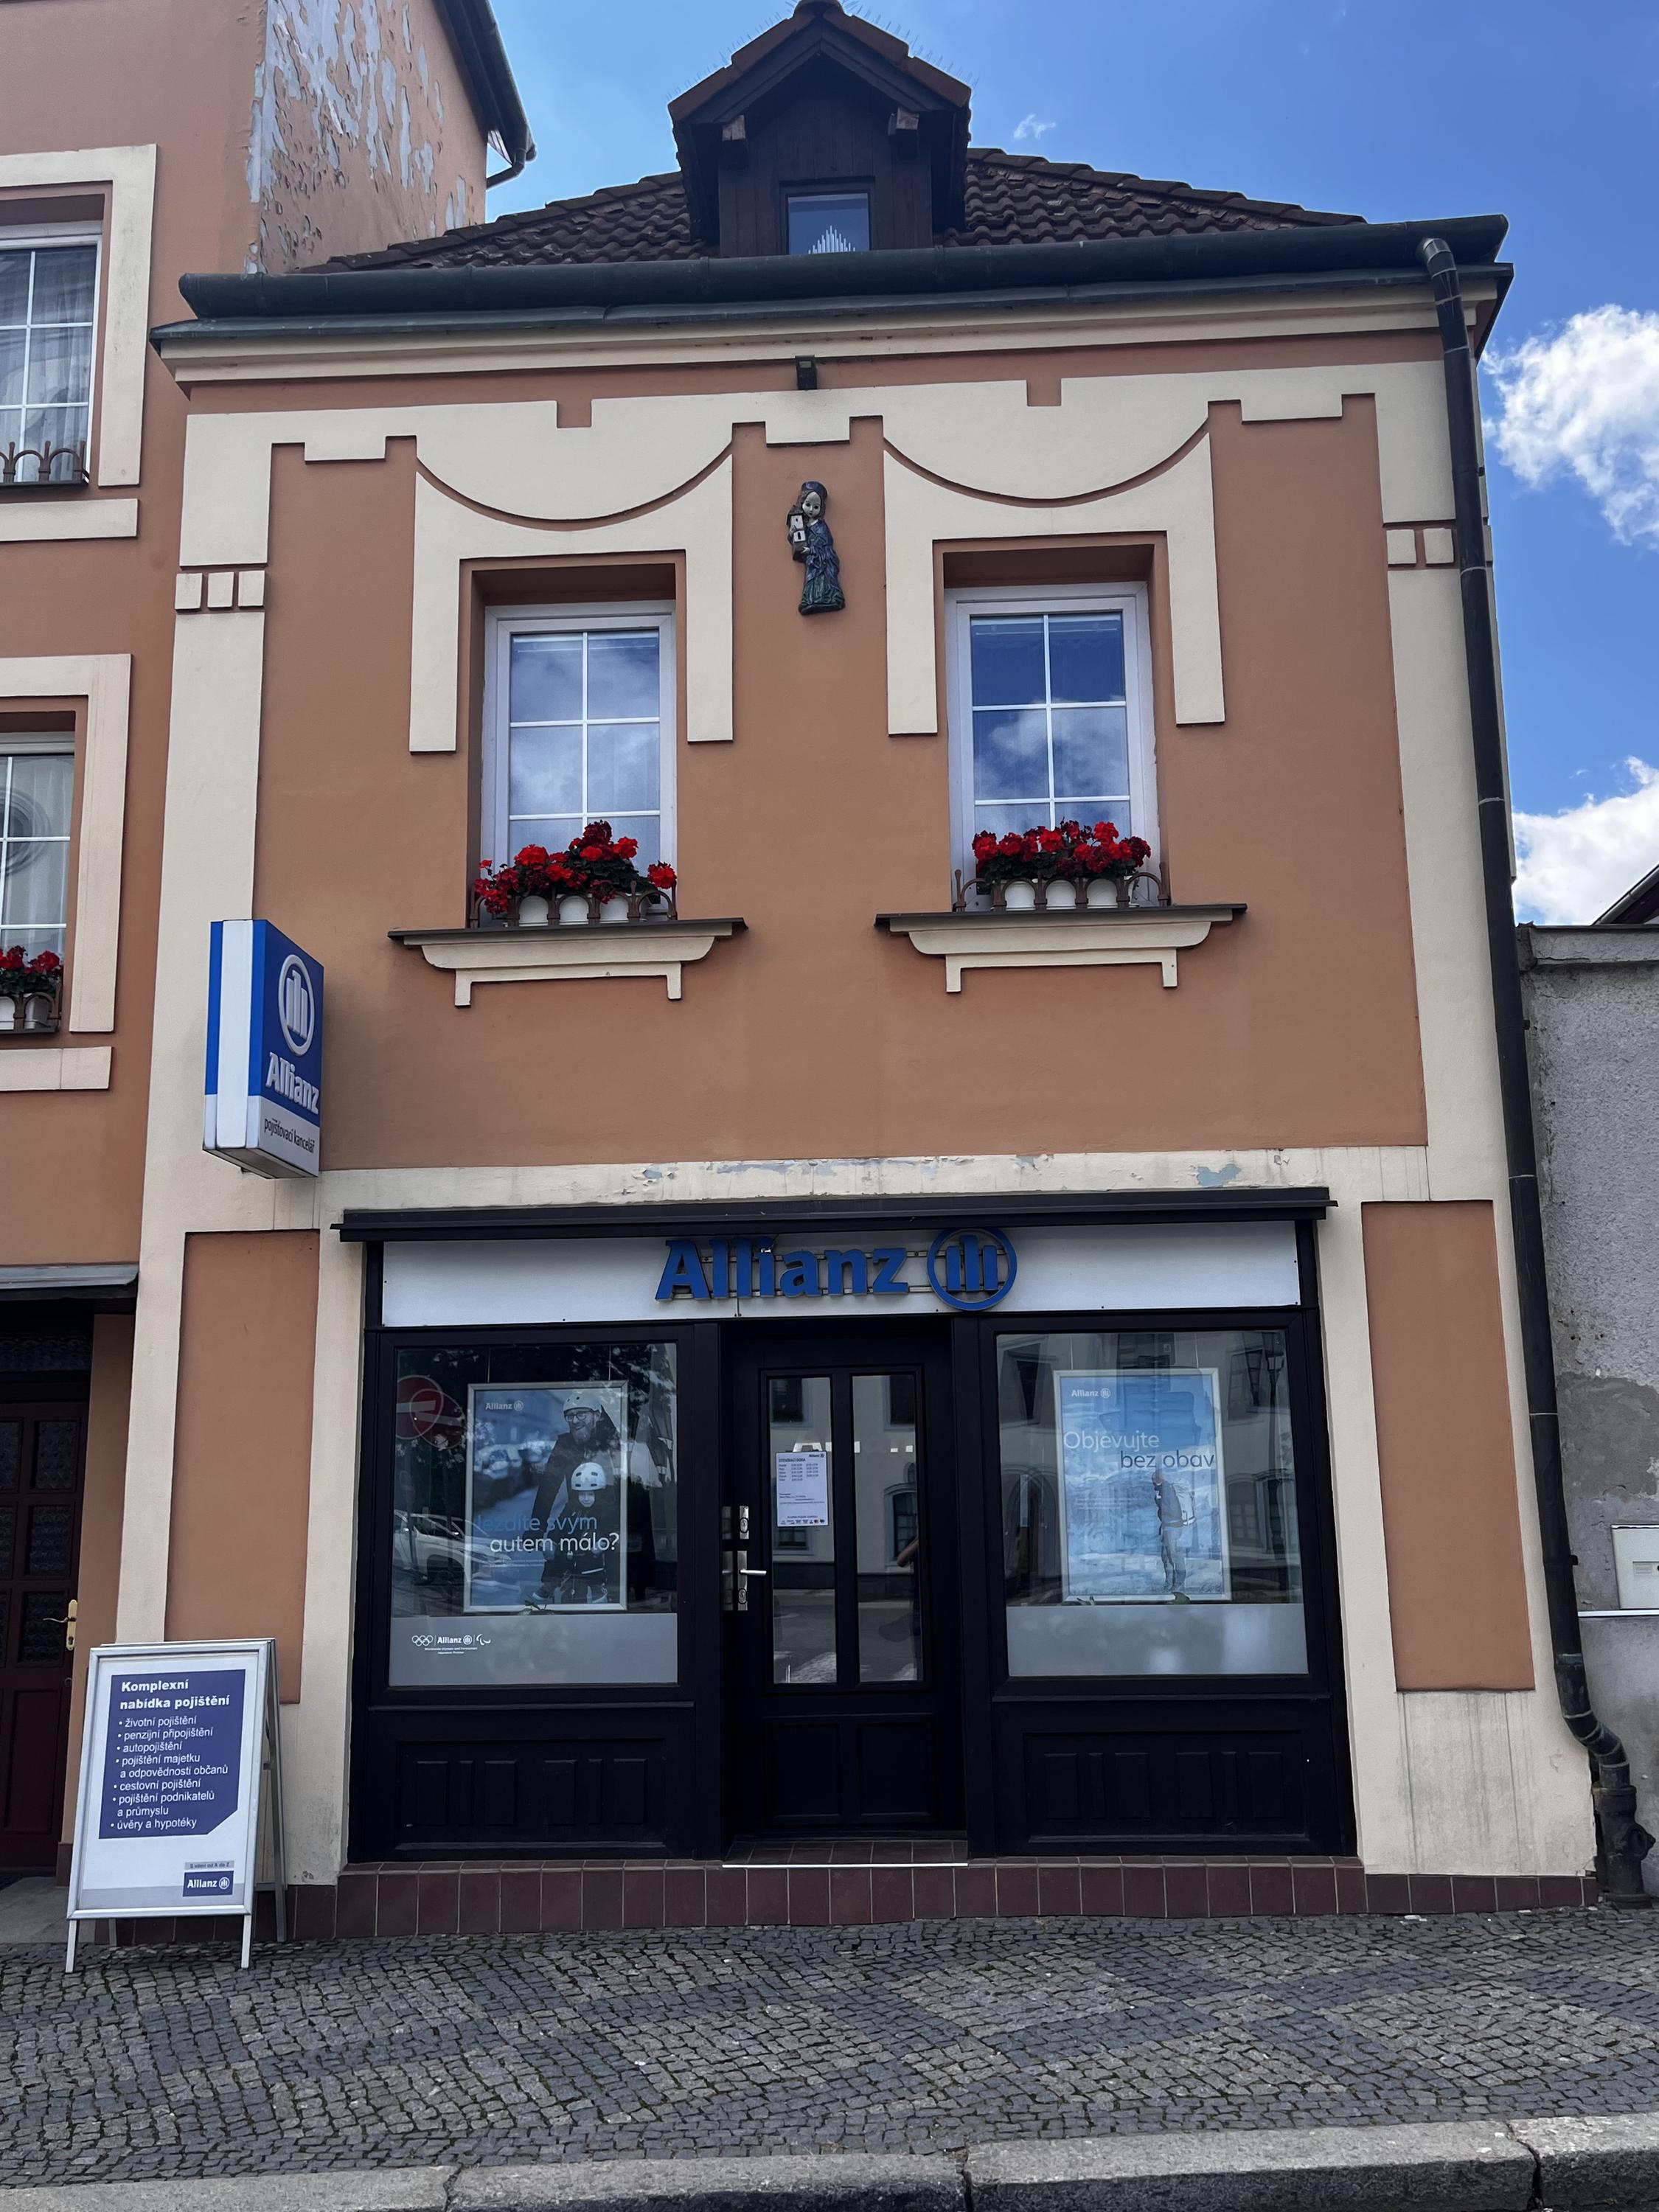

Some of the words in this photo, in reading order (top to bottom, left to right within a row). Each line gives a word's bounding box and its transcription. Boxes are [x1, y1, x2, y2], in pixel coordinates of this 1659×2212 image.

[265, 1051, 319, 1115] Allianz
[293, 1129, 316, 1154] kancelář
[655, 1236, 909, 1302] Allianz
[1071, 1389, 1099, 1398] Allianz
[484, 1402, 513, 1411] Allianz
[1063, 1430, 1161, 1453] Objevujte
[1120, 1450, 1157, 1468] bez
[1162, 1449, 1215, 1468] obav
[546, 1512, 598, 1534] svým
[490, 1535, 553, 1553] autem
[560, 1532, 620, 1552] málo?
[437, 1636, 462, 1644] Allianz
[121, 1678, 189, 1694] Komplexní
[119, 1698, 171, 1710] nabídka
[174, 1694, 231, 1710] pojištění
[125, 1717, 156, 1728] životní
[157, 1714, 198, 1728] pojištění
[123, 1728, 161, 1742] penzijní
[162, 1726, 214, 1740] připojištění
[122, 1741, 183, 1754] autopojištění
[122, 1754, 161, 1767] pojištění
[163, 1753, 201, 1765] majetku
[119, 1770, 126, 1778] a
[128, 1766, 191, 1779] odpovědnosti
[193, 1764, 229, 1775] občanů
[119, 1780, 159, 1791] cestovní
[161, 1778, 201, 1791] pojištění
[118, 1792, 159, 1806] pojištění
[160, 1790, 215, 1804] podnikatelů
[125, 1805, 170, 1818] průmyslu
[145, 1820, 152, 1829] a
[154, 1817, 197, 1830] hypotéky
[187, 1879, 218, 1888] Allianz
